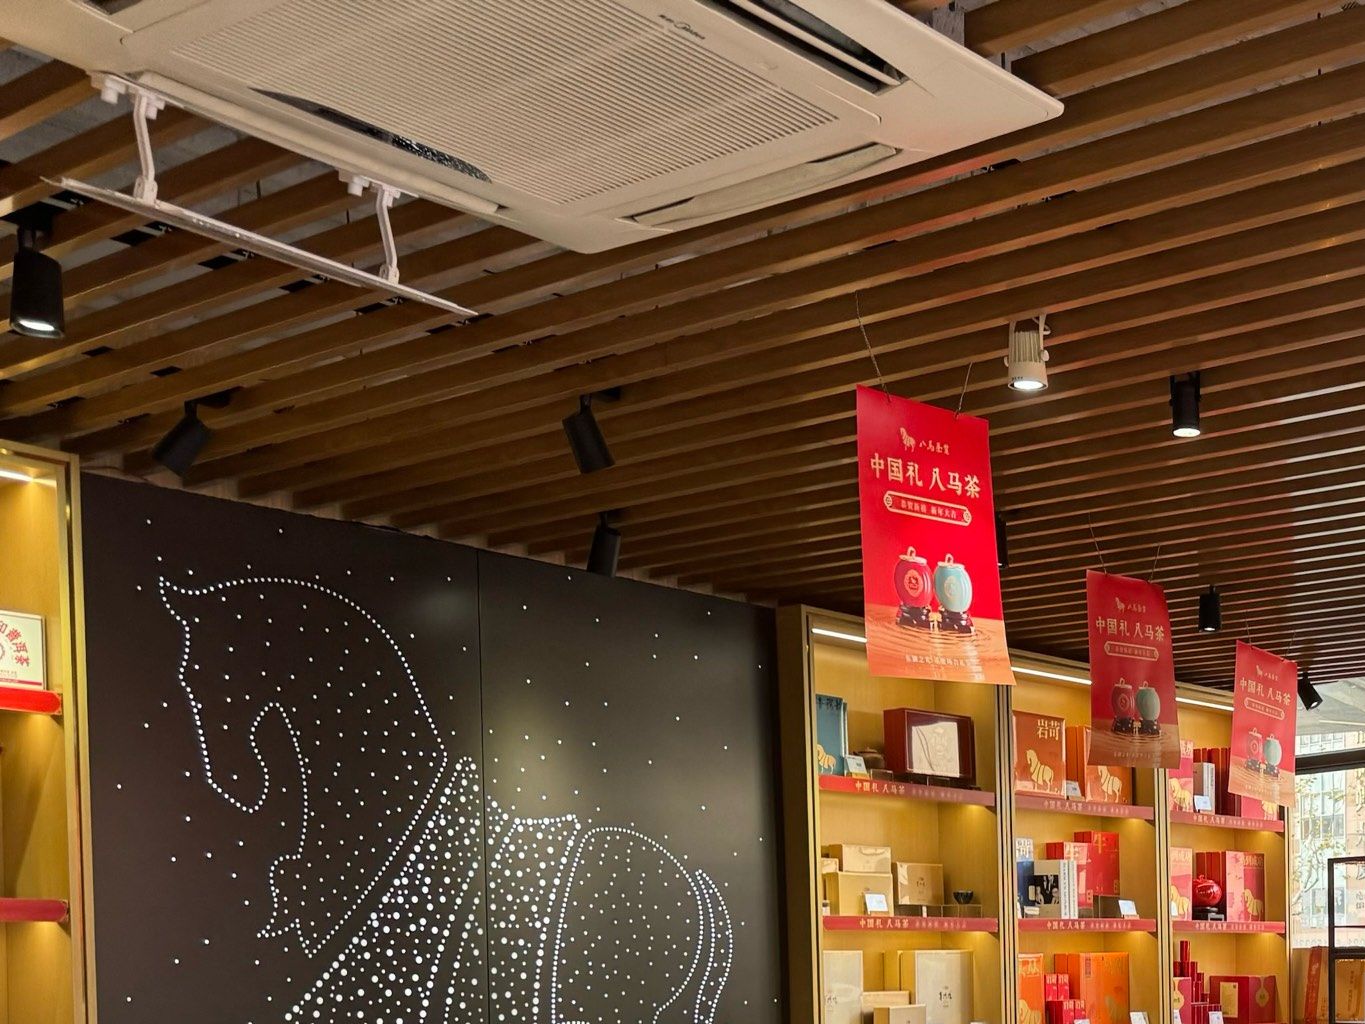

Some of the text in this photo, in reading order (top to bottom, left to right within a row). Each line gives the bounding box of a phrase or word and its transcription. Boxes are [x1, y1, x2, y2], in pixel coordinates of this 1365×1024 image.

[870, 452, 981, 499] 中国礼 八马茶
[1095, 616, 1165, 642] 中国礼 八马茶
[1239, 677, 1291, 708] 中国礼 八马茶
[859, 918, 883, 929] 中国礼
[887, 918, 909, 929] 八马茶
